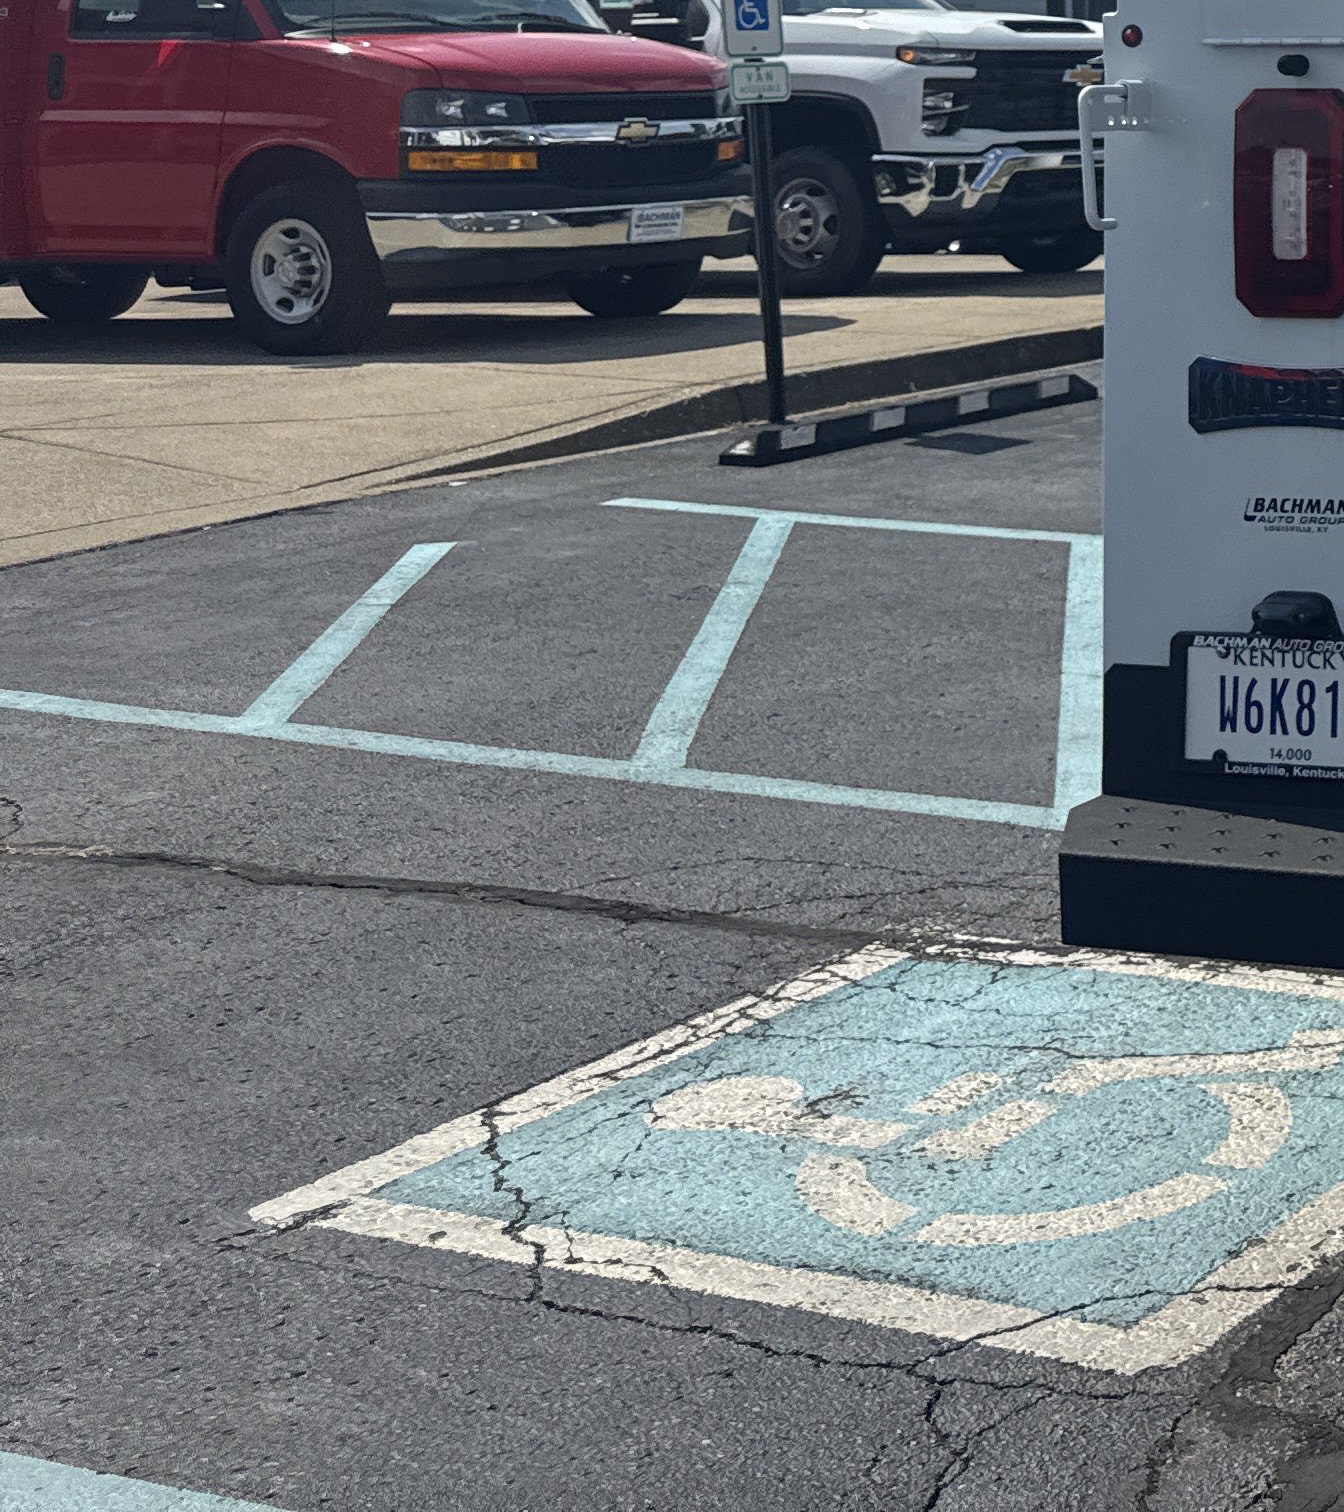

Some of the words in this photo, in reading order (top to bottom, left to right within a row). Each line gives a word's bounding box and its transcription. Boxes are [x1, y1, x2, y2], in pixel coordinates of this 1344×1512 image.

[1257, 515, 1295, 524] AUTO
[1269, 748, 1313, 762] 14,000
[1224, 762, 1290, 778] Louisville,
